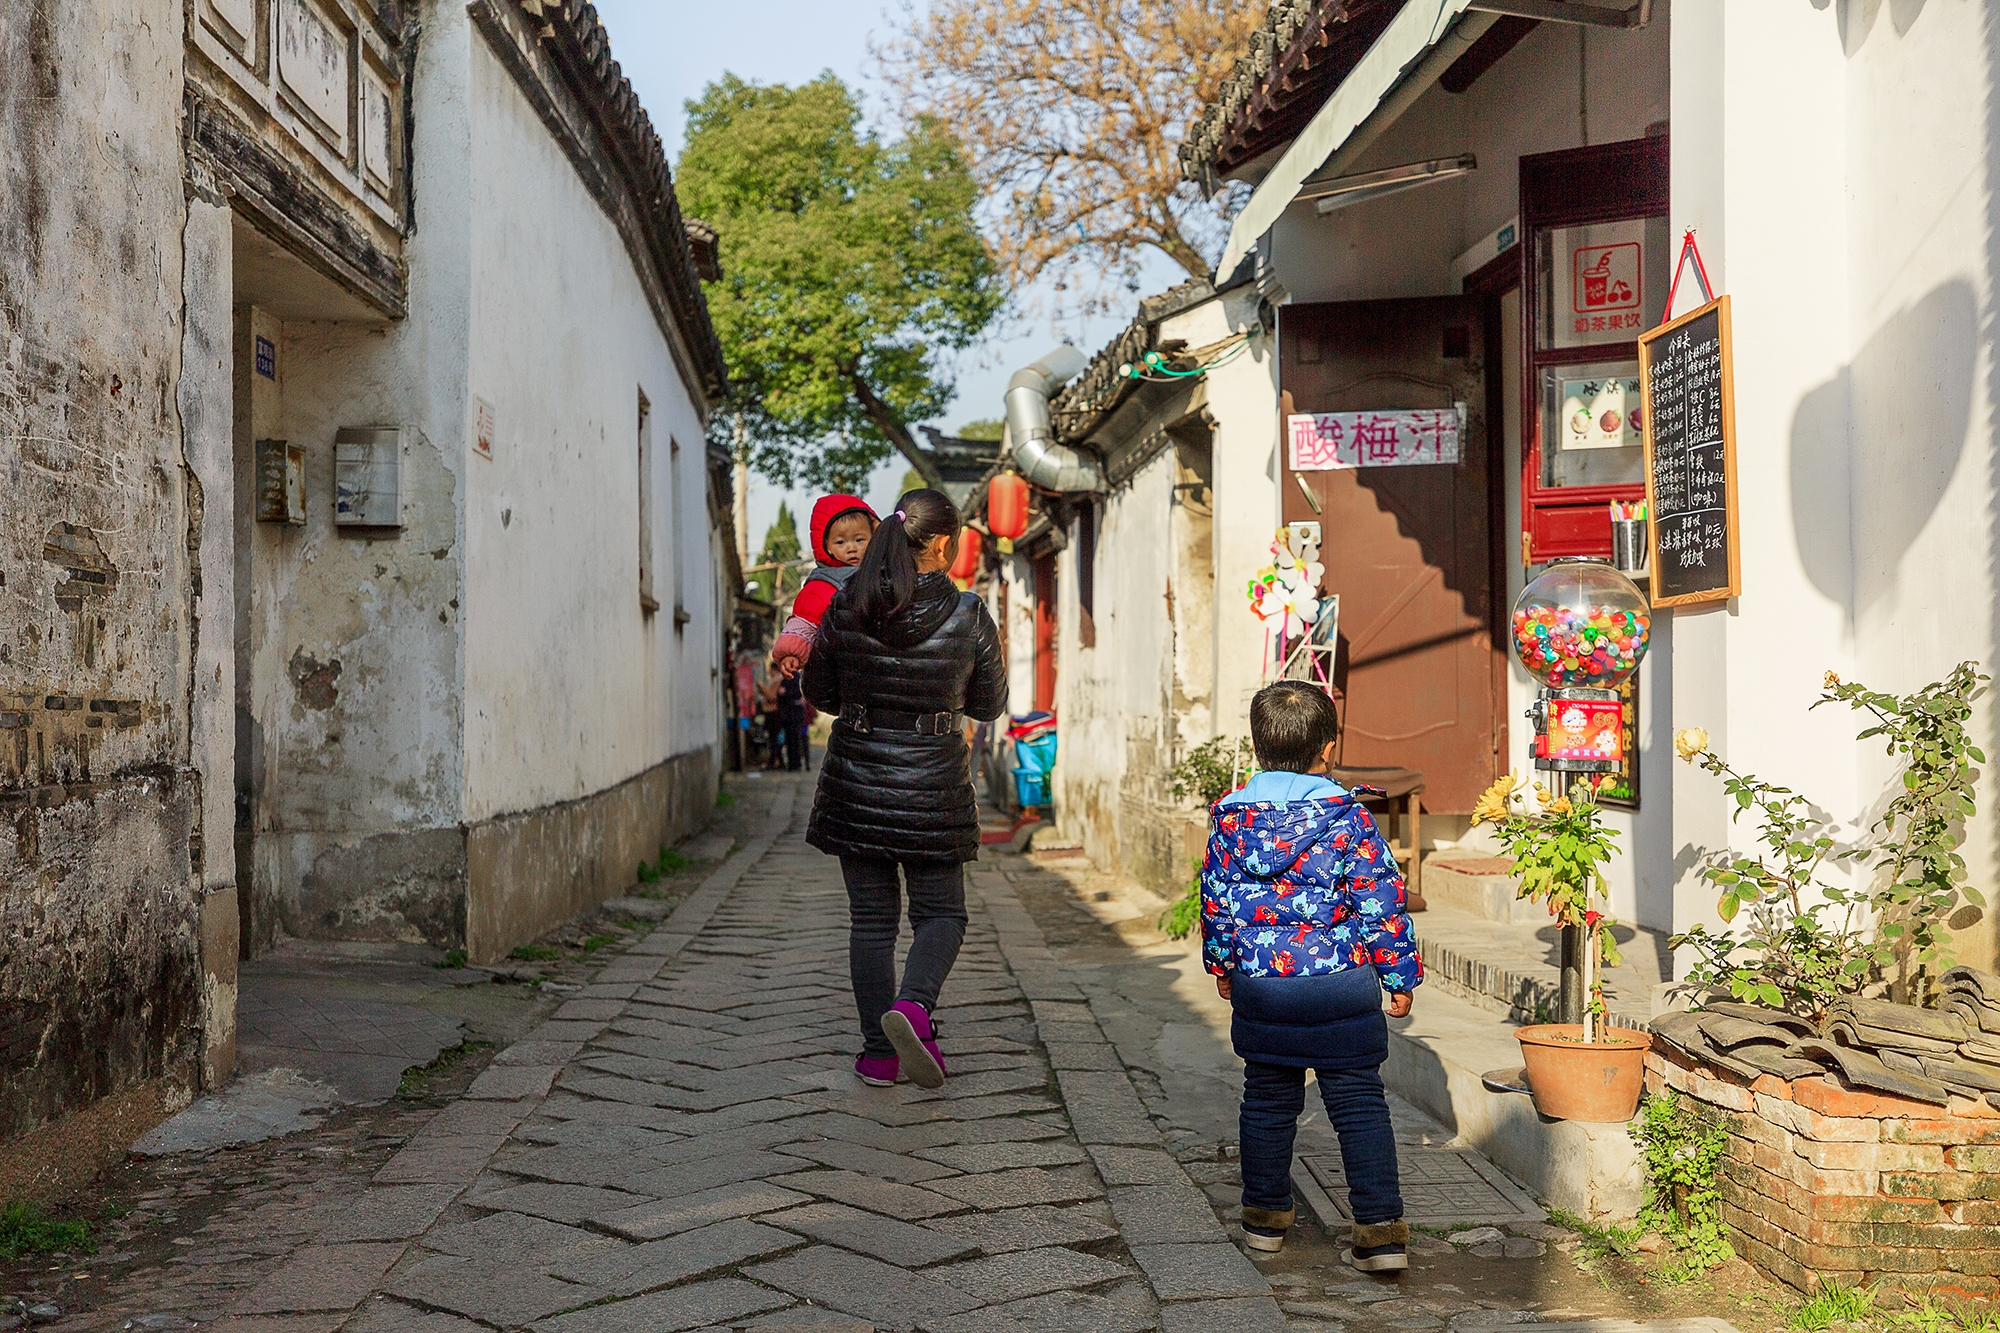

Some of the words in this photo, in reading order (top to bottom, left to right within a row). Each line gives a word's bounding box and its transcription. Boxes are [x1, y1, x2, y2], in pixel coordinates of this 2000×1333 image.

[1575, 313, 1641, 333] 奶茶果饮
[1293, 412, 1456, 467] 酸梅汁
